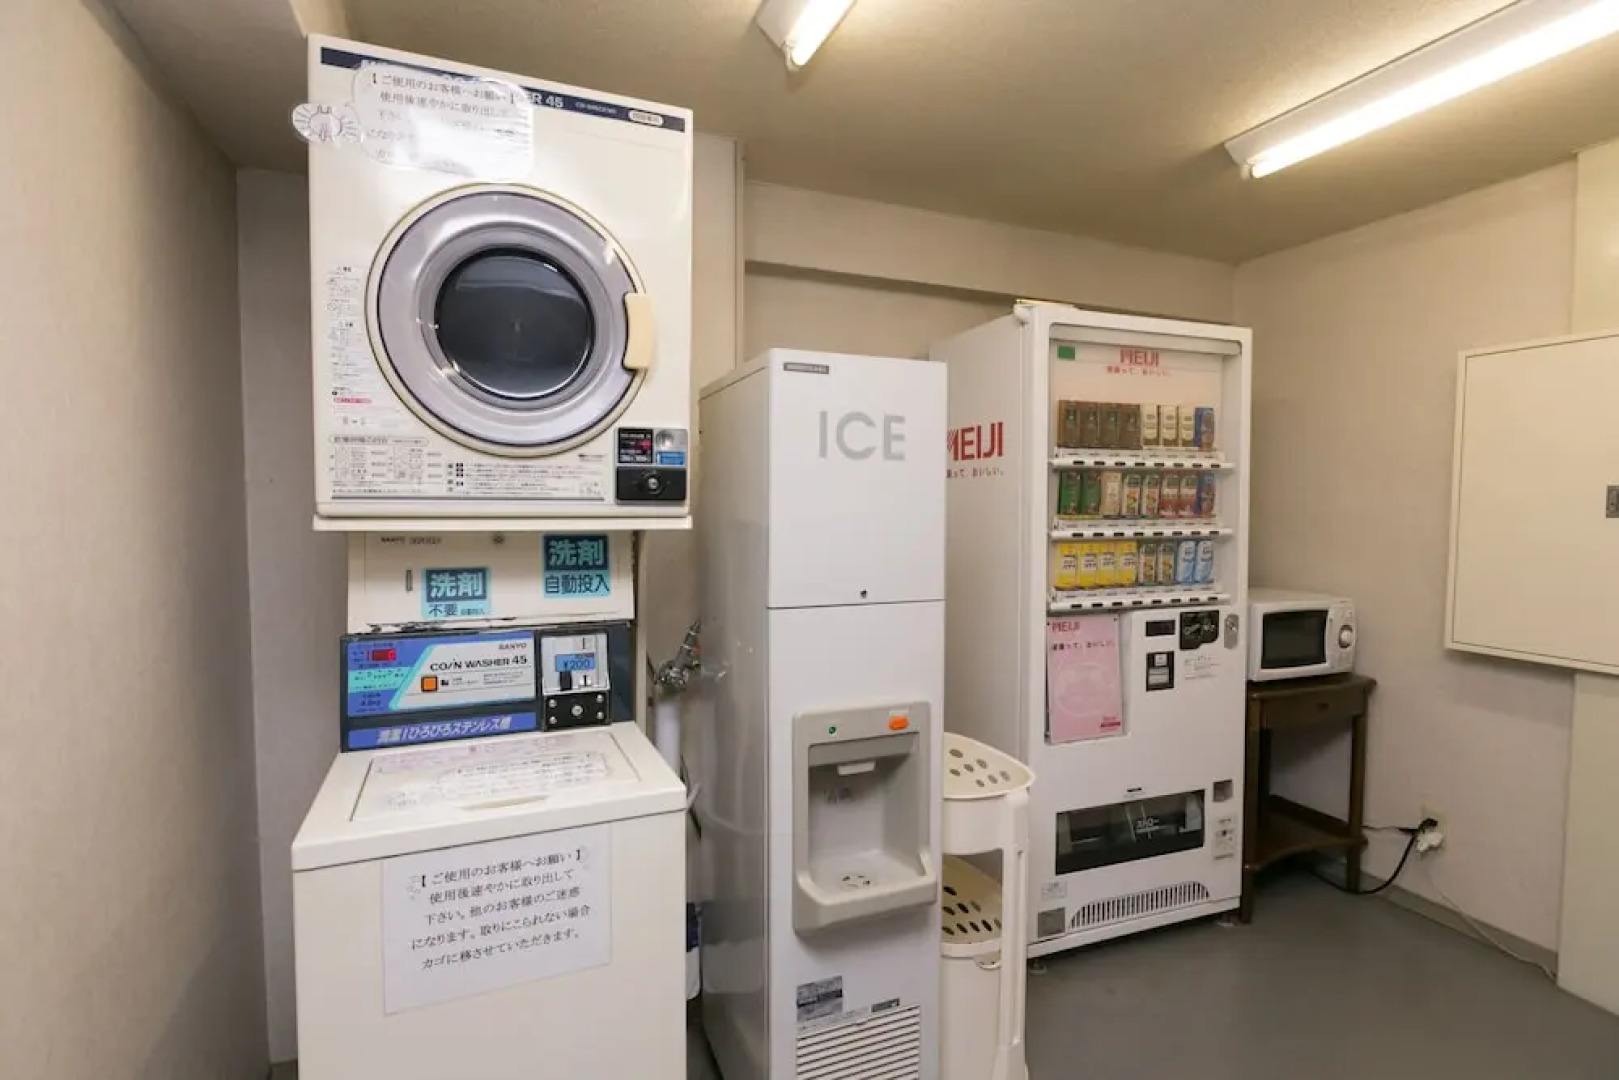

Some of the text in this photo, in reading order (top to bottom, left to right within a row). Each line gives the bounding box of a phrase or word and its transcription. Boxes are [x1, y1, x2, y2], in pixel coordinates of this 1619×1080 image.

[546, 94, 564, 108] 45
[818, 410, 906, 461] ICE
[548, 538, 605, 566] 洗剤
[430, 572, 484, 599] 洗剤
[545, 573, 610, 595] 自動投入
[428, 603, 459, 618] 不要
[464, 658, 511, 669] WASHER
[512, 655, 528, 666] 45
